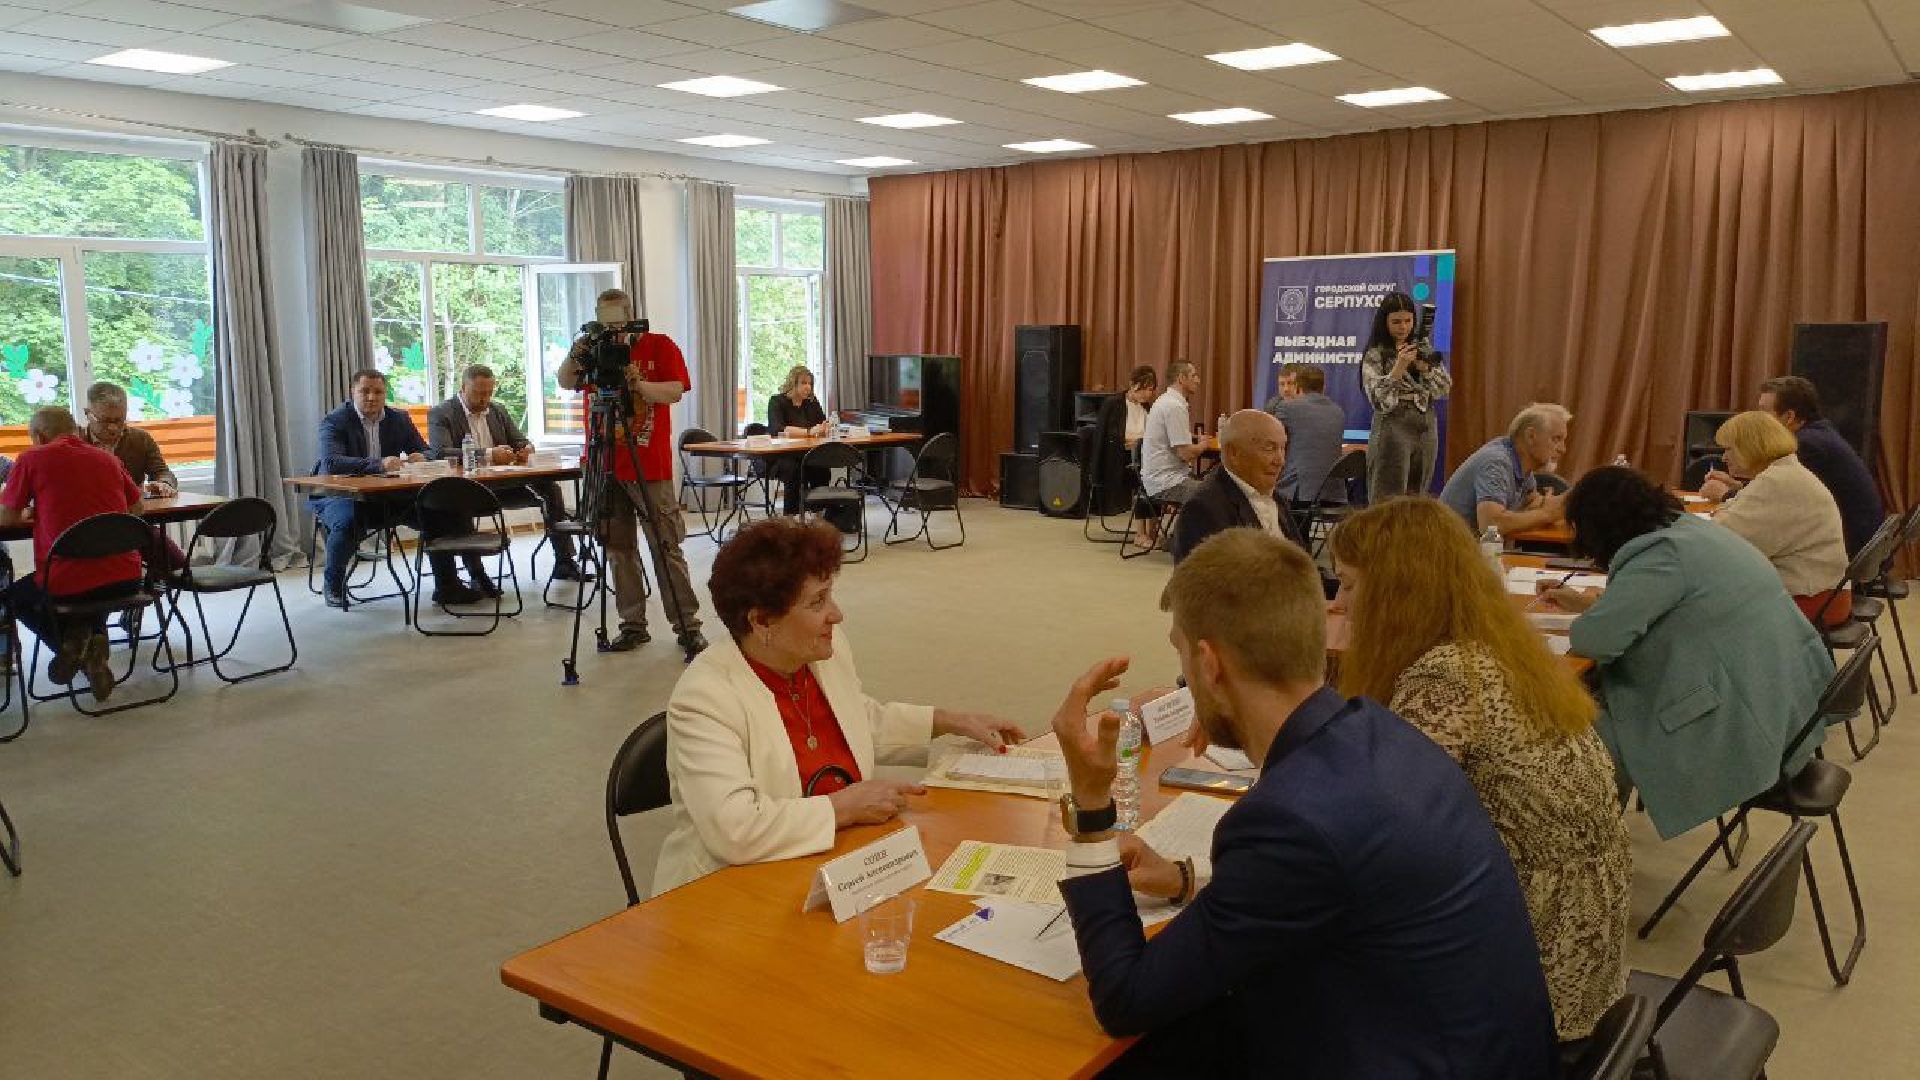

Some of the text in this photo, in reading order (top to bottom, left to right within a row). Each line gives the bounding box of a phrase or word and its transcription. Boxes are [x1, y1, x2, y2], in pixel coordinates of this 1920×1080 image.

[1315, 283, 1397, 294] ГОРОДСКОЙ ОКРУГ
[1274, 336, 1357, 348] ВЫЕЗДНАЯ
